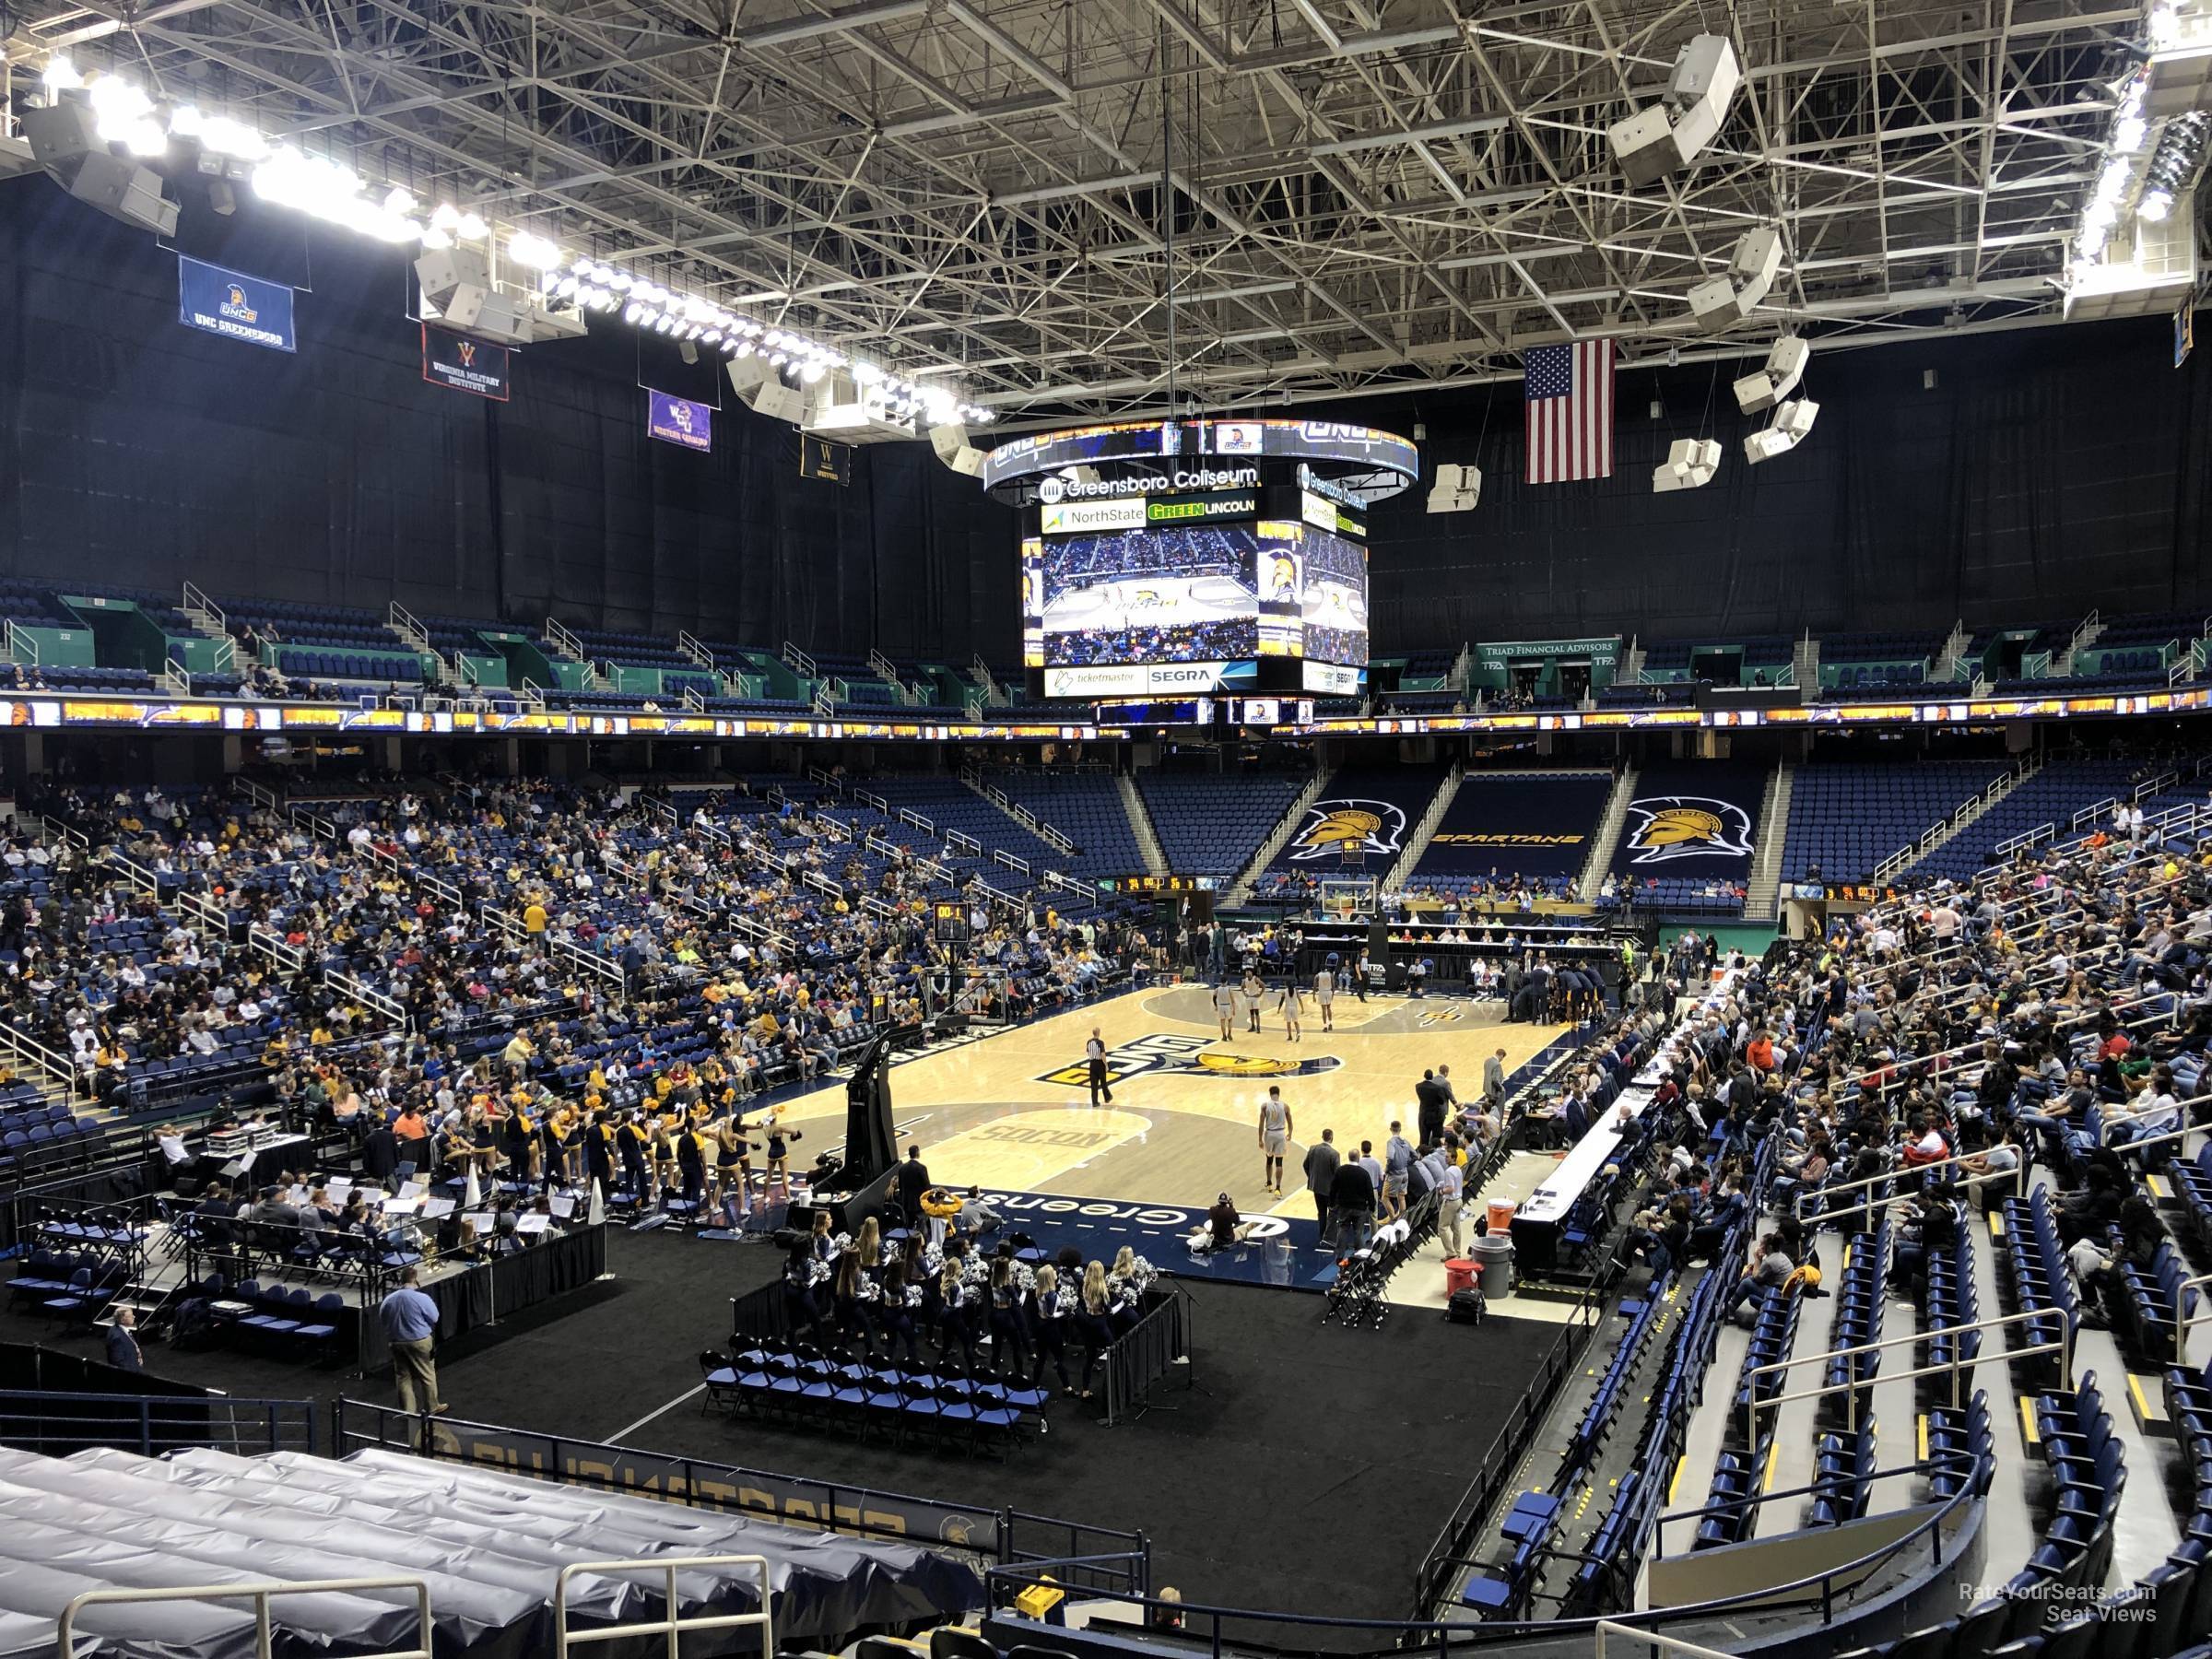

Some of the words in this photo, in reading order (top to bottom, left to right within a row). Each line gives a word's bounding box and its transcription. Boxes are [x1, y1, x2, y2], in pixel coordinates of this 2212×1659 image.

[221, 303, 257, 323] UNCG
[194, 313, 217, 328] UNC
[219, 320, 283, 346] GREENSBORO
[433, 361, 465, 379] VIRGINIA
[466, 371, 500, 387] MILITARY
[449, 375, 486, 393] INSTITUTE
[1224, 441, 1252, 450] UNCG
[1066, 476, 1169, 497] Greensboro
[1174, 467, 1257, 488] Coliseum
[1310, 471, 1343, 500] Greensboro
[1343, 488, 1368, 512] Coliseum
[1071, 509, 1144, 524] NorthState
[1148, 502, 1205, 520] GREEN
[1205, 500, 1255, 515] LINCOLN
[1486, 647, 1514, 656] TRIAD
[1516, 645, 1565, 654] FINANCIAL
[1567, 643, 1613, 653] ADVISORS
[1481, 661, 1505, 670] TFA
[1077, 672, 1135, 683] ticketmaster
[1152, 670, 1210, 683] SEGRA
[1430, 834, 1585, 843] SPARTANS
